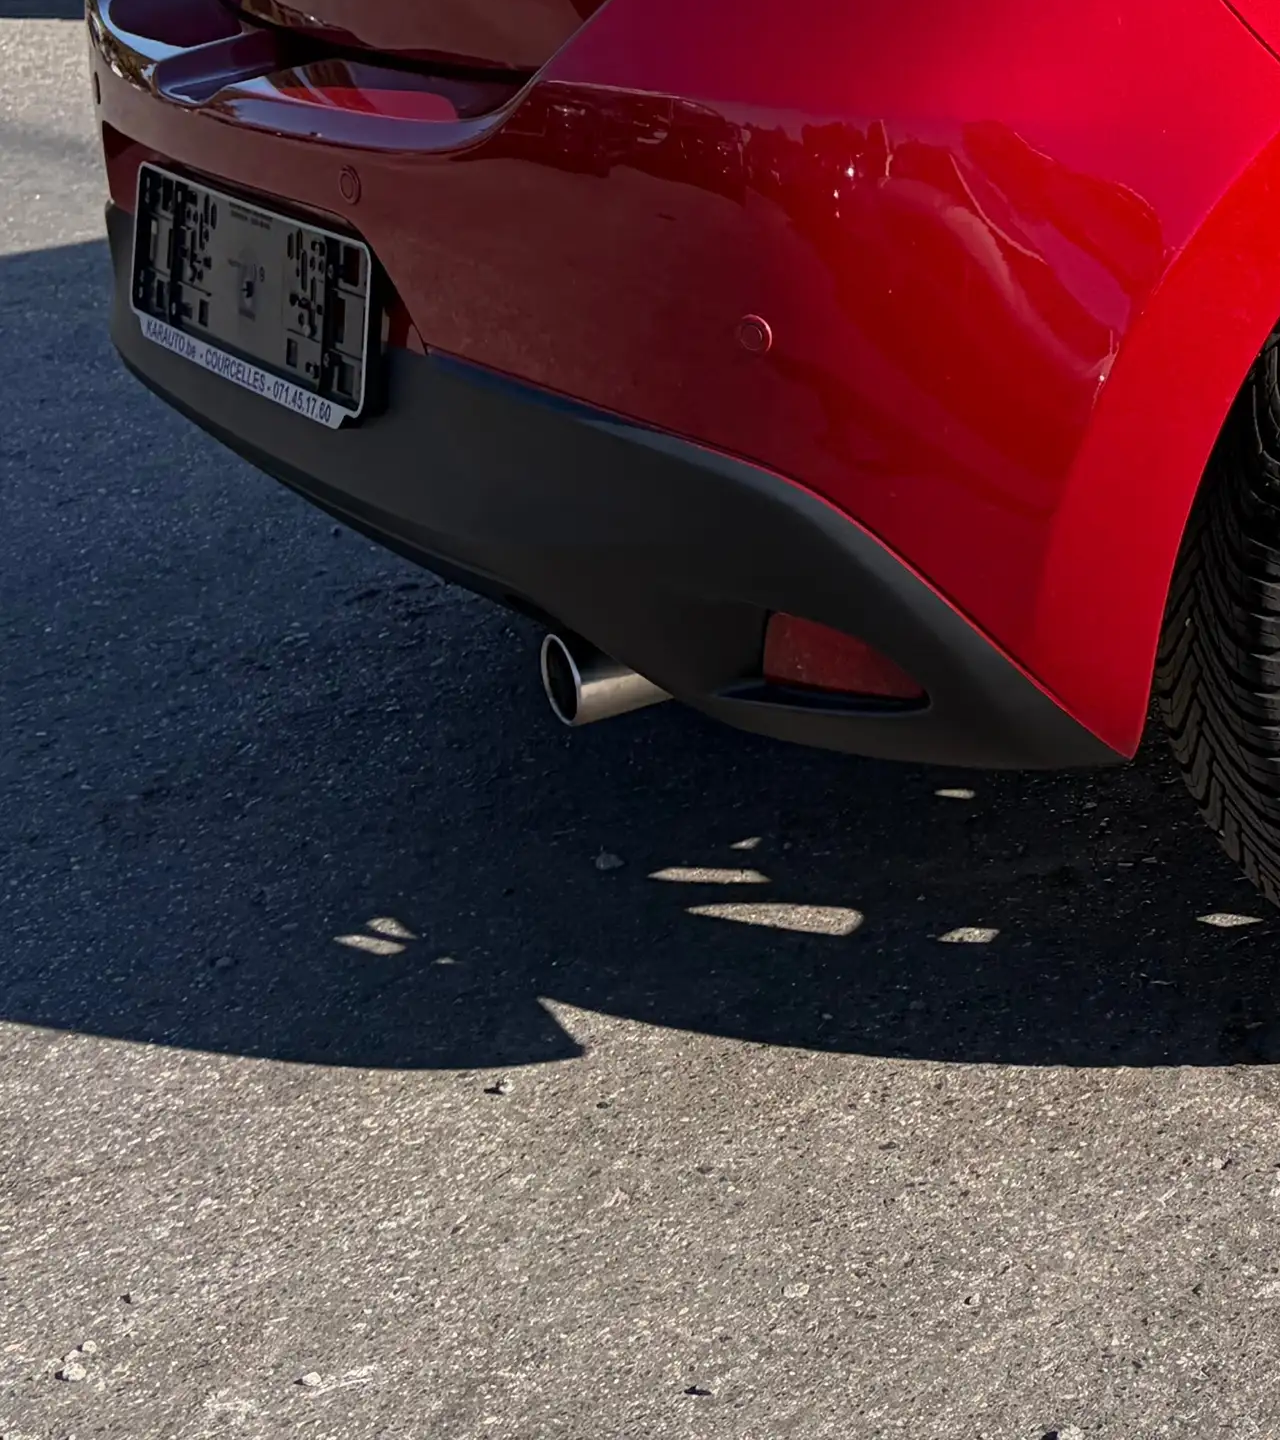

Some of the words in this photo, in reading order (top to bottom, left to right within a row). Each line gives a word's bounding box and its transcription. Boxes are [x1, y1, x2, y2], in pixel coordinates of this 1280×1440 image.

[145, 320, 197, 360] KARAUTO.be
[204, 349, 267, 392] COURCELLES
[272, 380, 332, 423] 071.45.17.60
